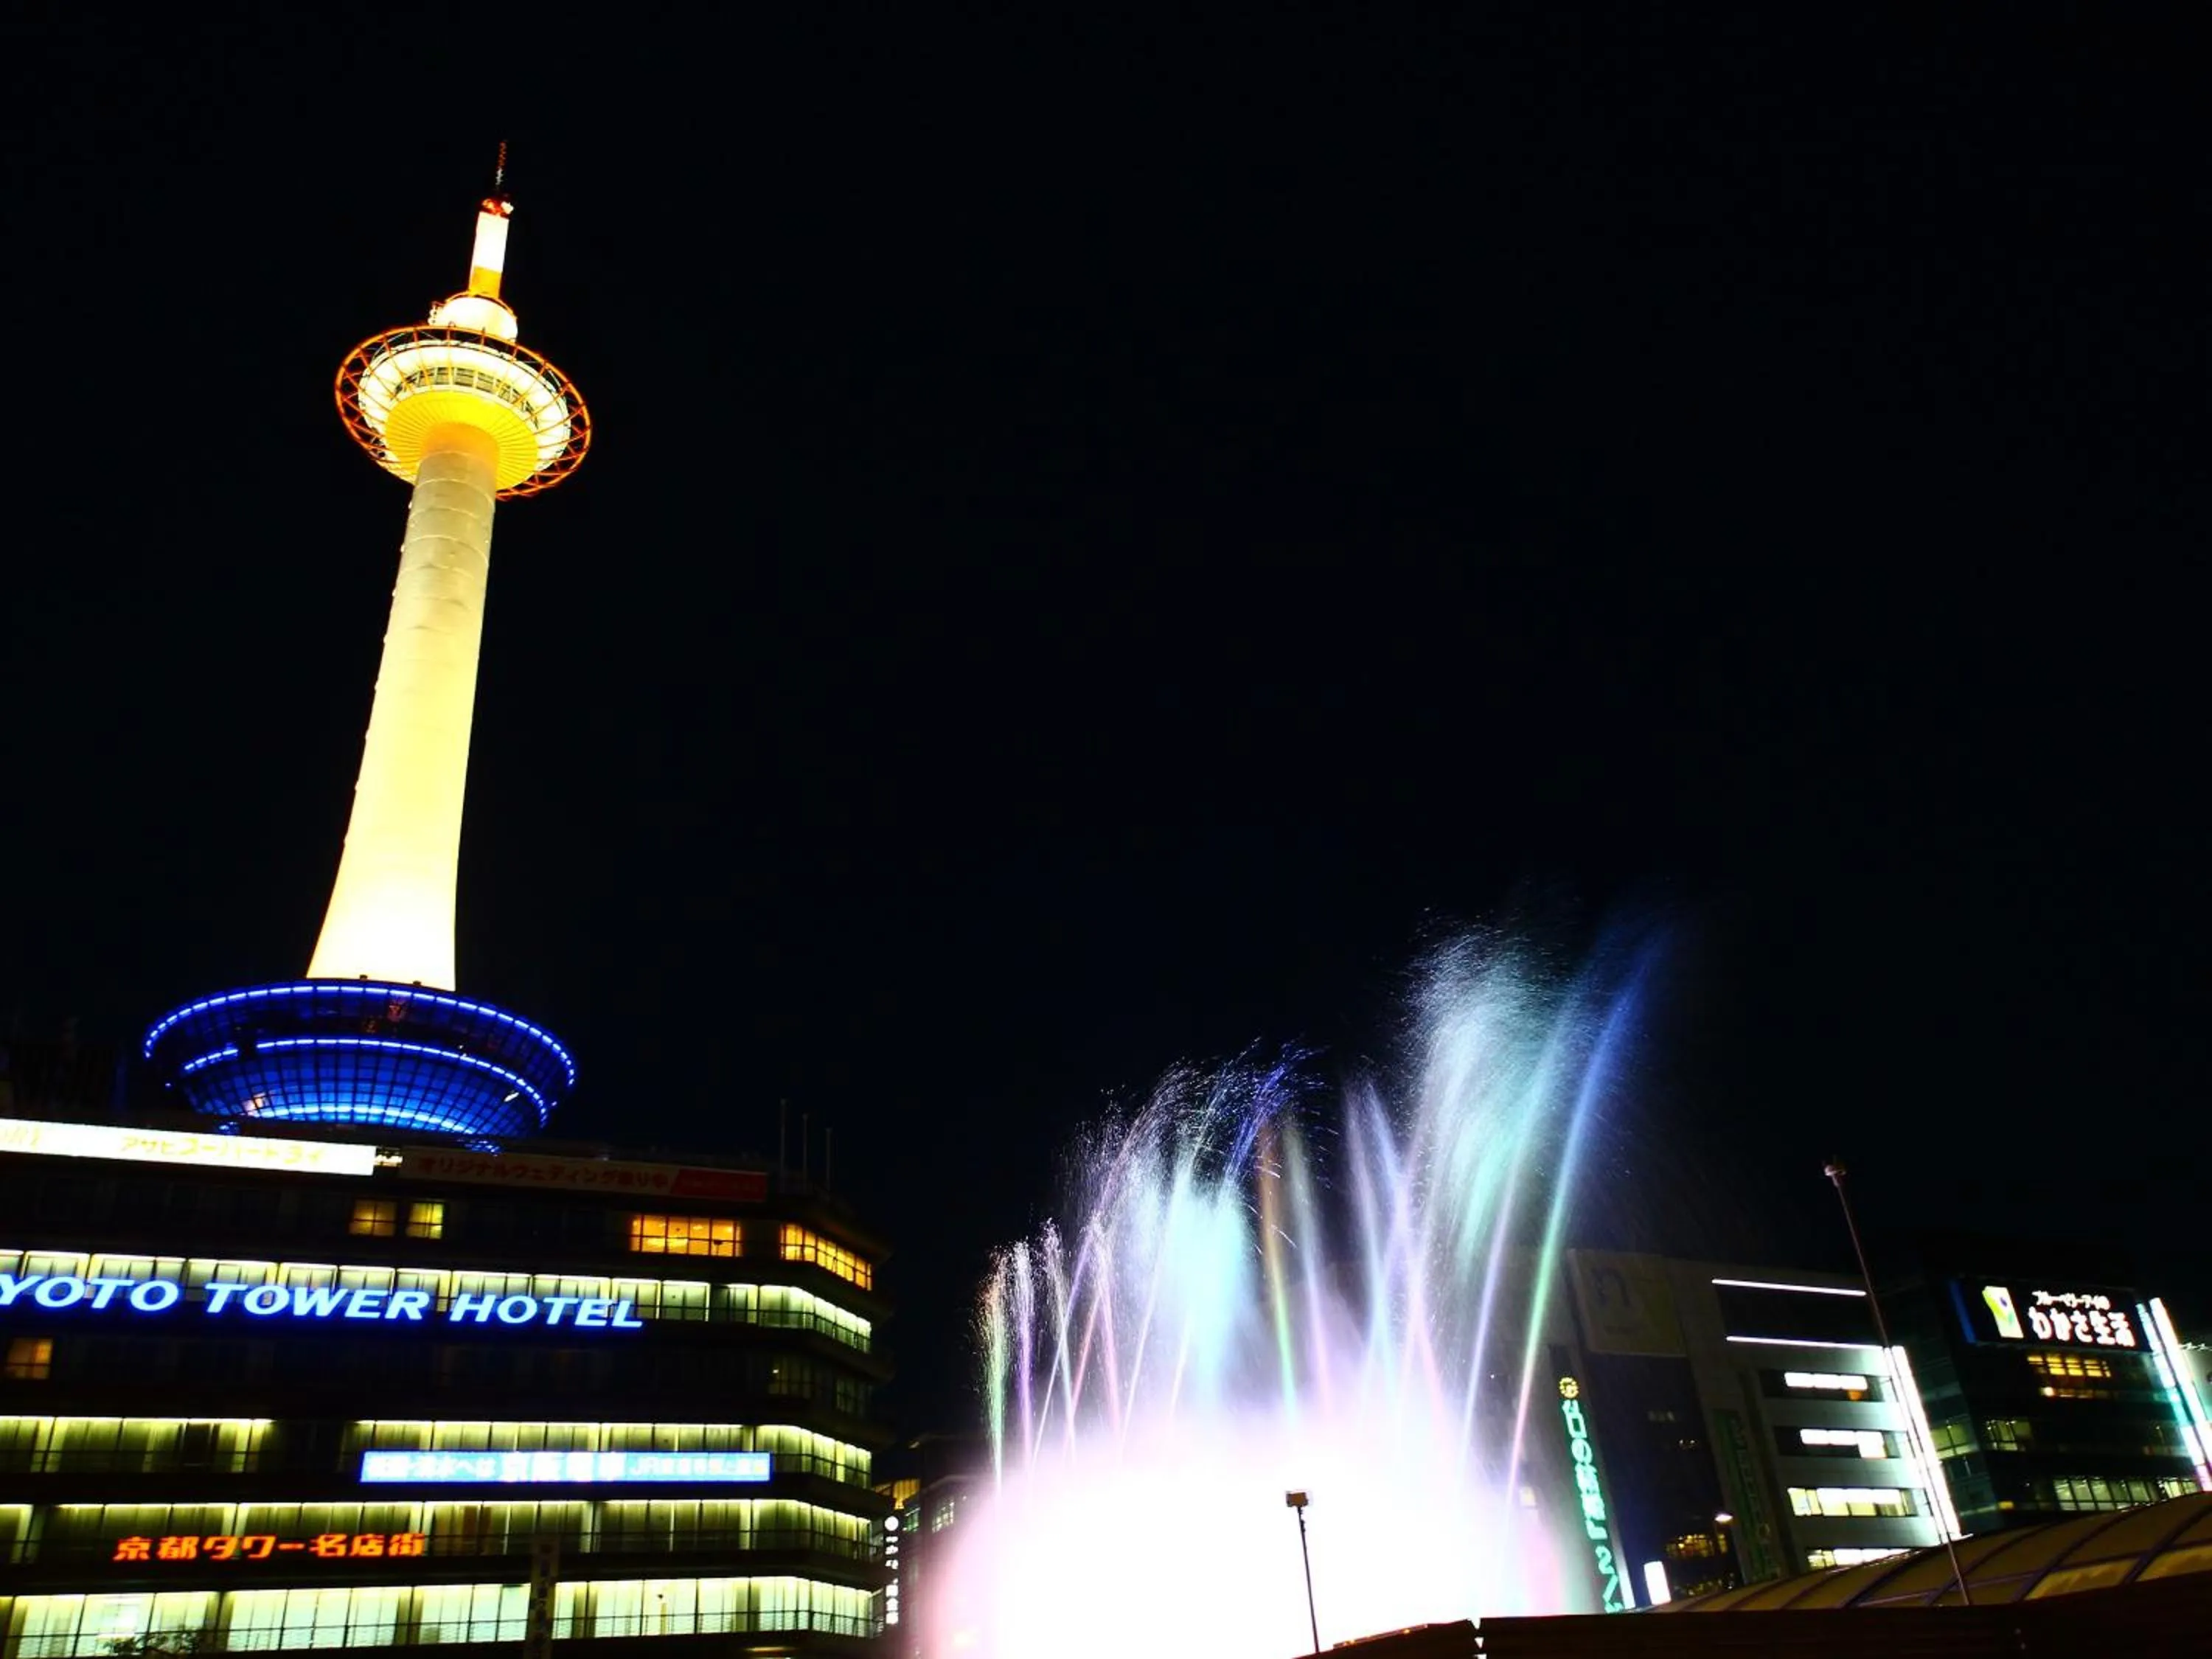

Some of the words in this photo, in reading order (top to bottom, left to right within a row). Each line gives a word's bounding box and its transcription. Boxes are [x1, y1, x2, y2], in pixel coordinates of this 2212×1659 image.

[205, 1282, 431, 1320] TOWER
[450, 1293, 643, 1328] HOTEL
[2028, 1306, 2135, 1347] わかさ生活
[114, 1532, 425, 1561] 京都タワー名店街
